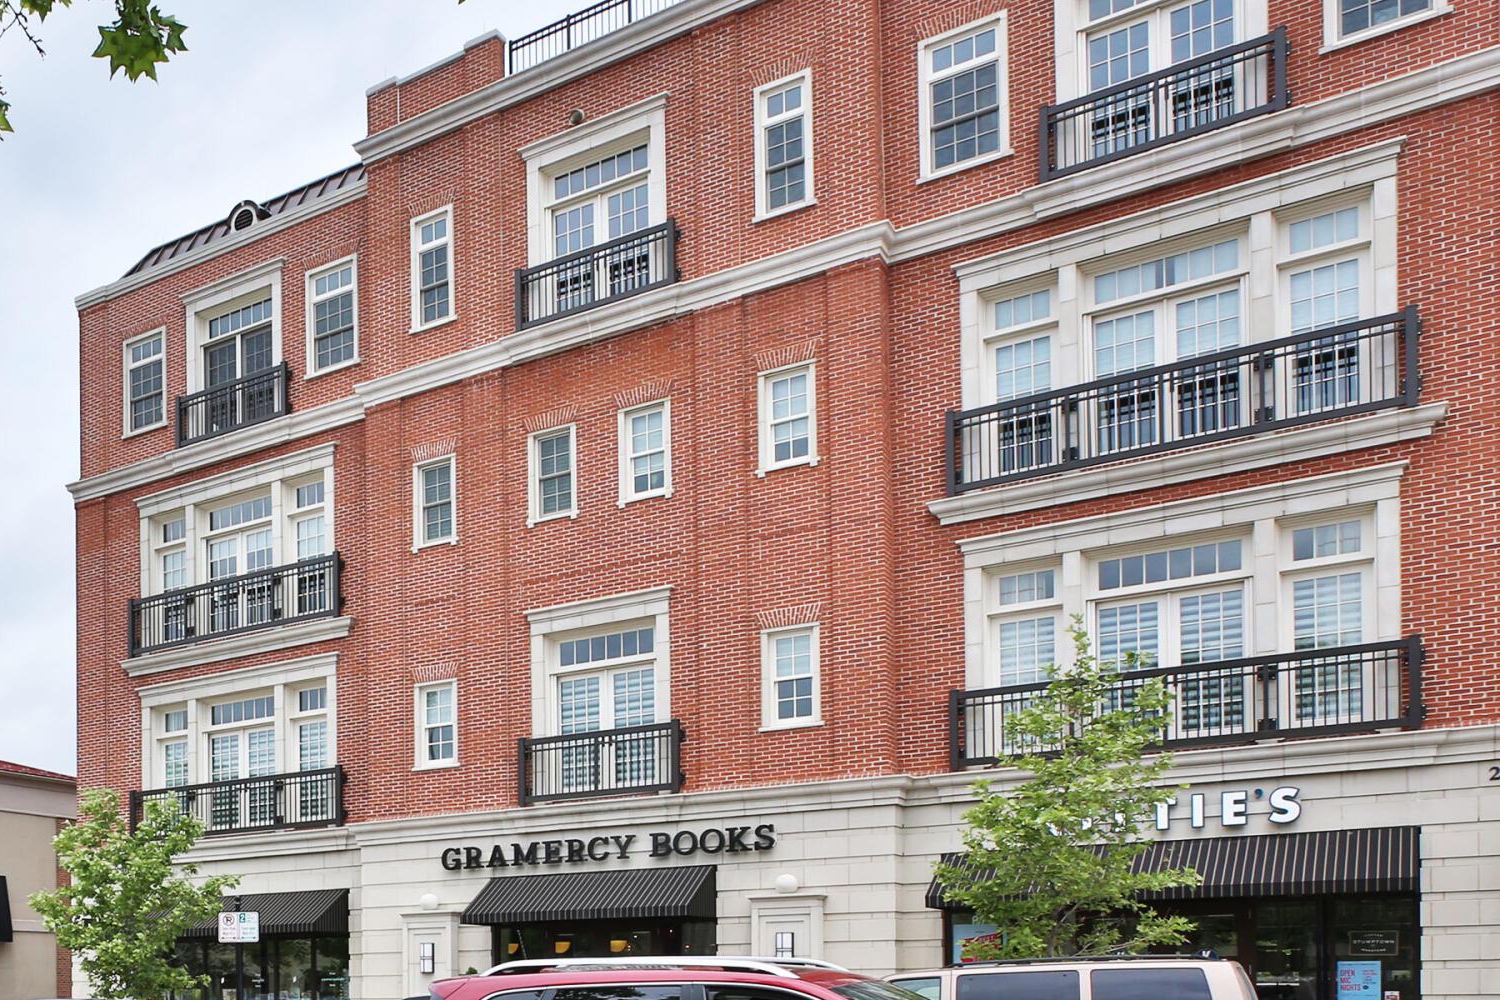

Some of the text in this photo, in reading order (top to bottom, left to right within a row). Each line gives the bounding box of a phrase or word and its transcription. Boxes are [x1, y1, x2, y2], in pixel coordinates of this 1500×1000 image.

[1489, 766, 1500, 781] 2
[441, 824, 776, 872] GRAMERCY BOOKS
